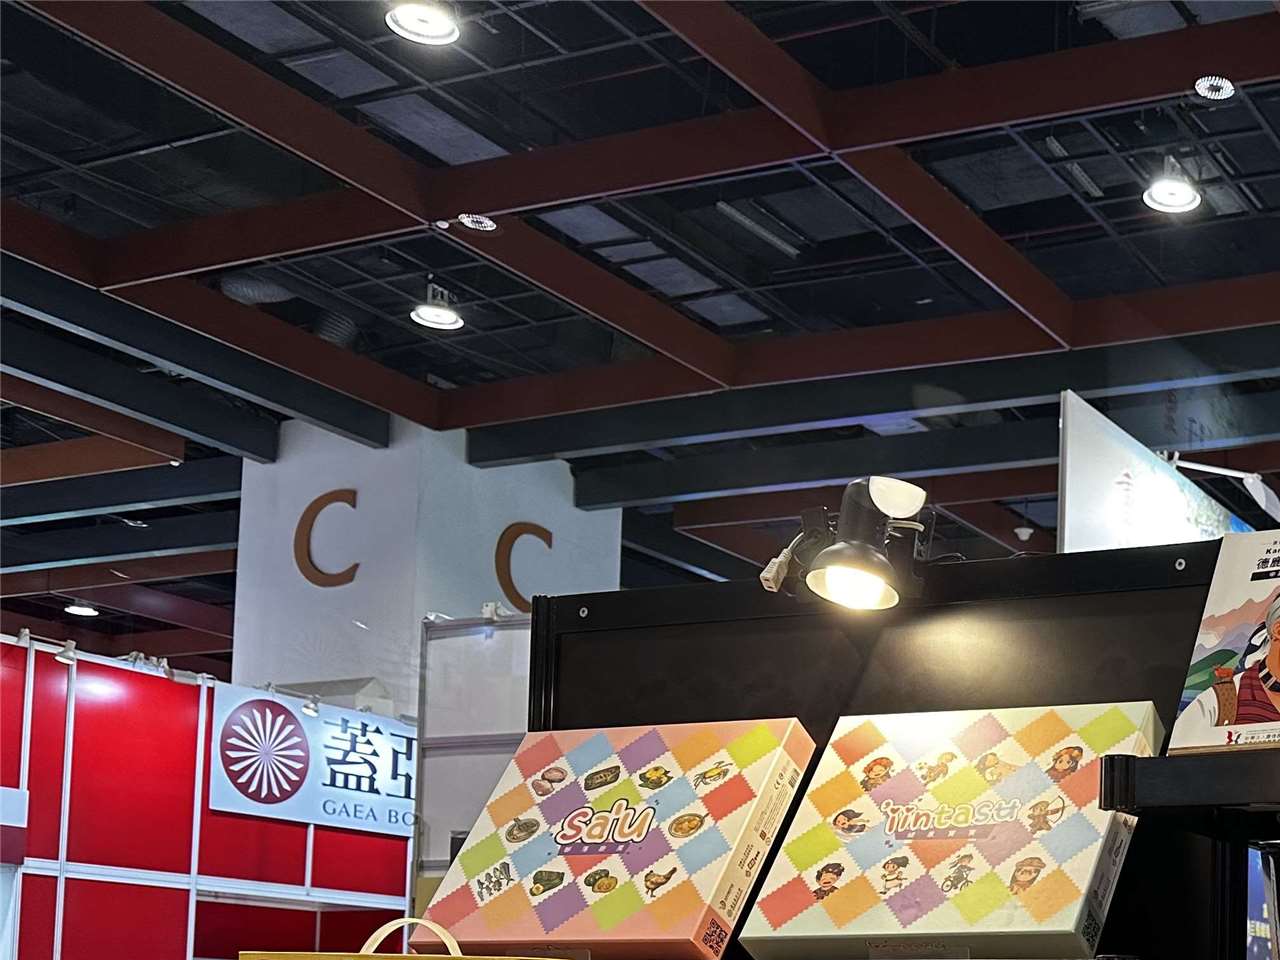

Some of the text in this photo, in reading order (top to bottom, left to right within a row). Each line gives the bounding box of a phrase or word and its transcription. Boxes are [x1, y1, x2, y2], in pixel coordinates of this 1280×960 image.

[294, 489, 360, 588] C
[495, 521, 553, 612] C
[322, 801, 377, 821] GAEA
